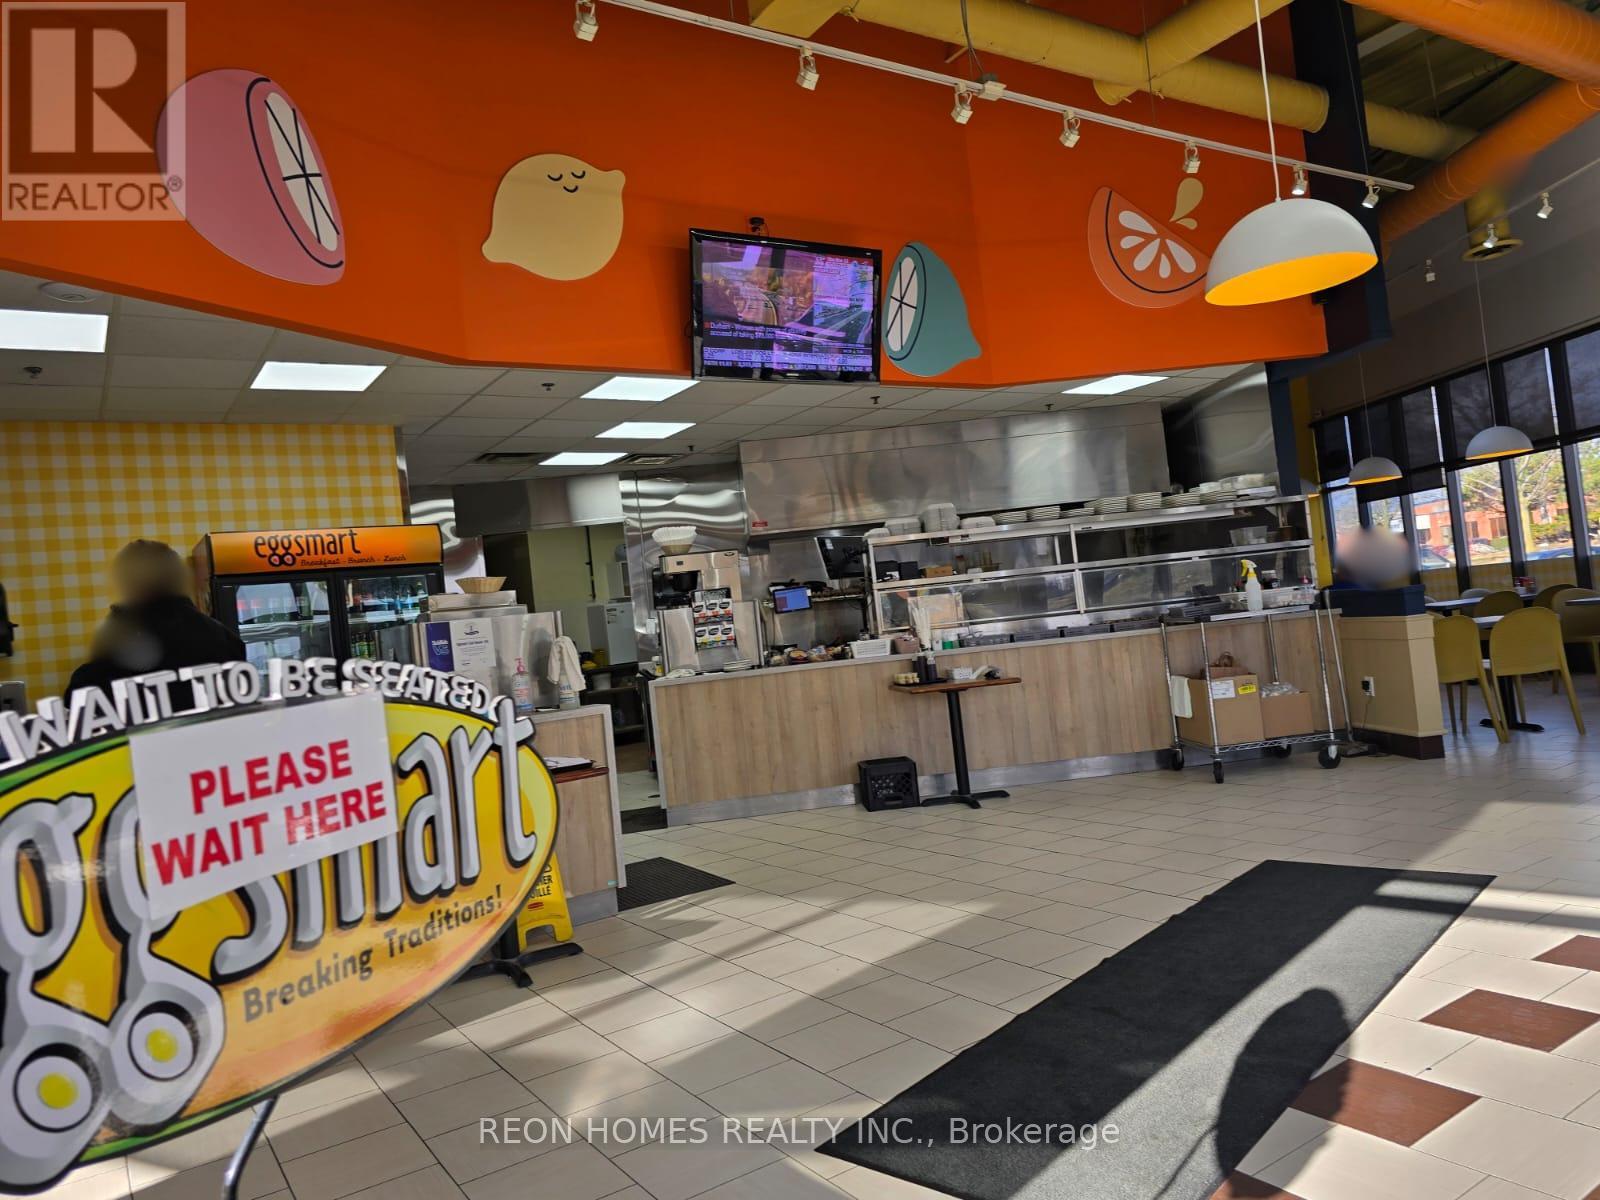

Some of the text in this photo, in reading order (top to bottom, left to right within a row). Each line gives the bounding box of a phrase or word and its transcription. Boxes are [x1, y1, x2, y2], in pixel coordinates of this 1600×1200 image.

[254, 529, 361, 567] eggsmart
[0, 657, 491, 762] WAIT TO BE SEATED
[190, 739, 352, 815] PLEASE
[151, 781, 387, 886] WAIT HERE
[243, 884, 502, 1023] Breaking Traditions!
